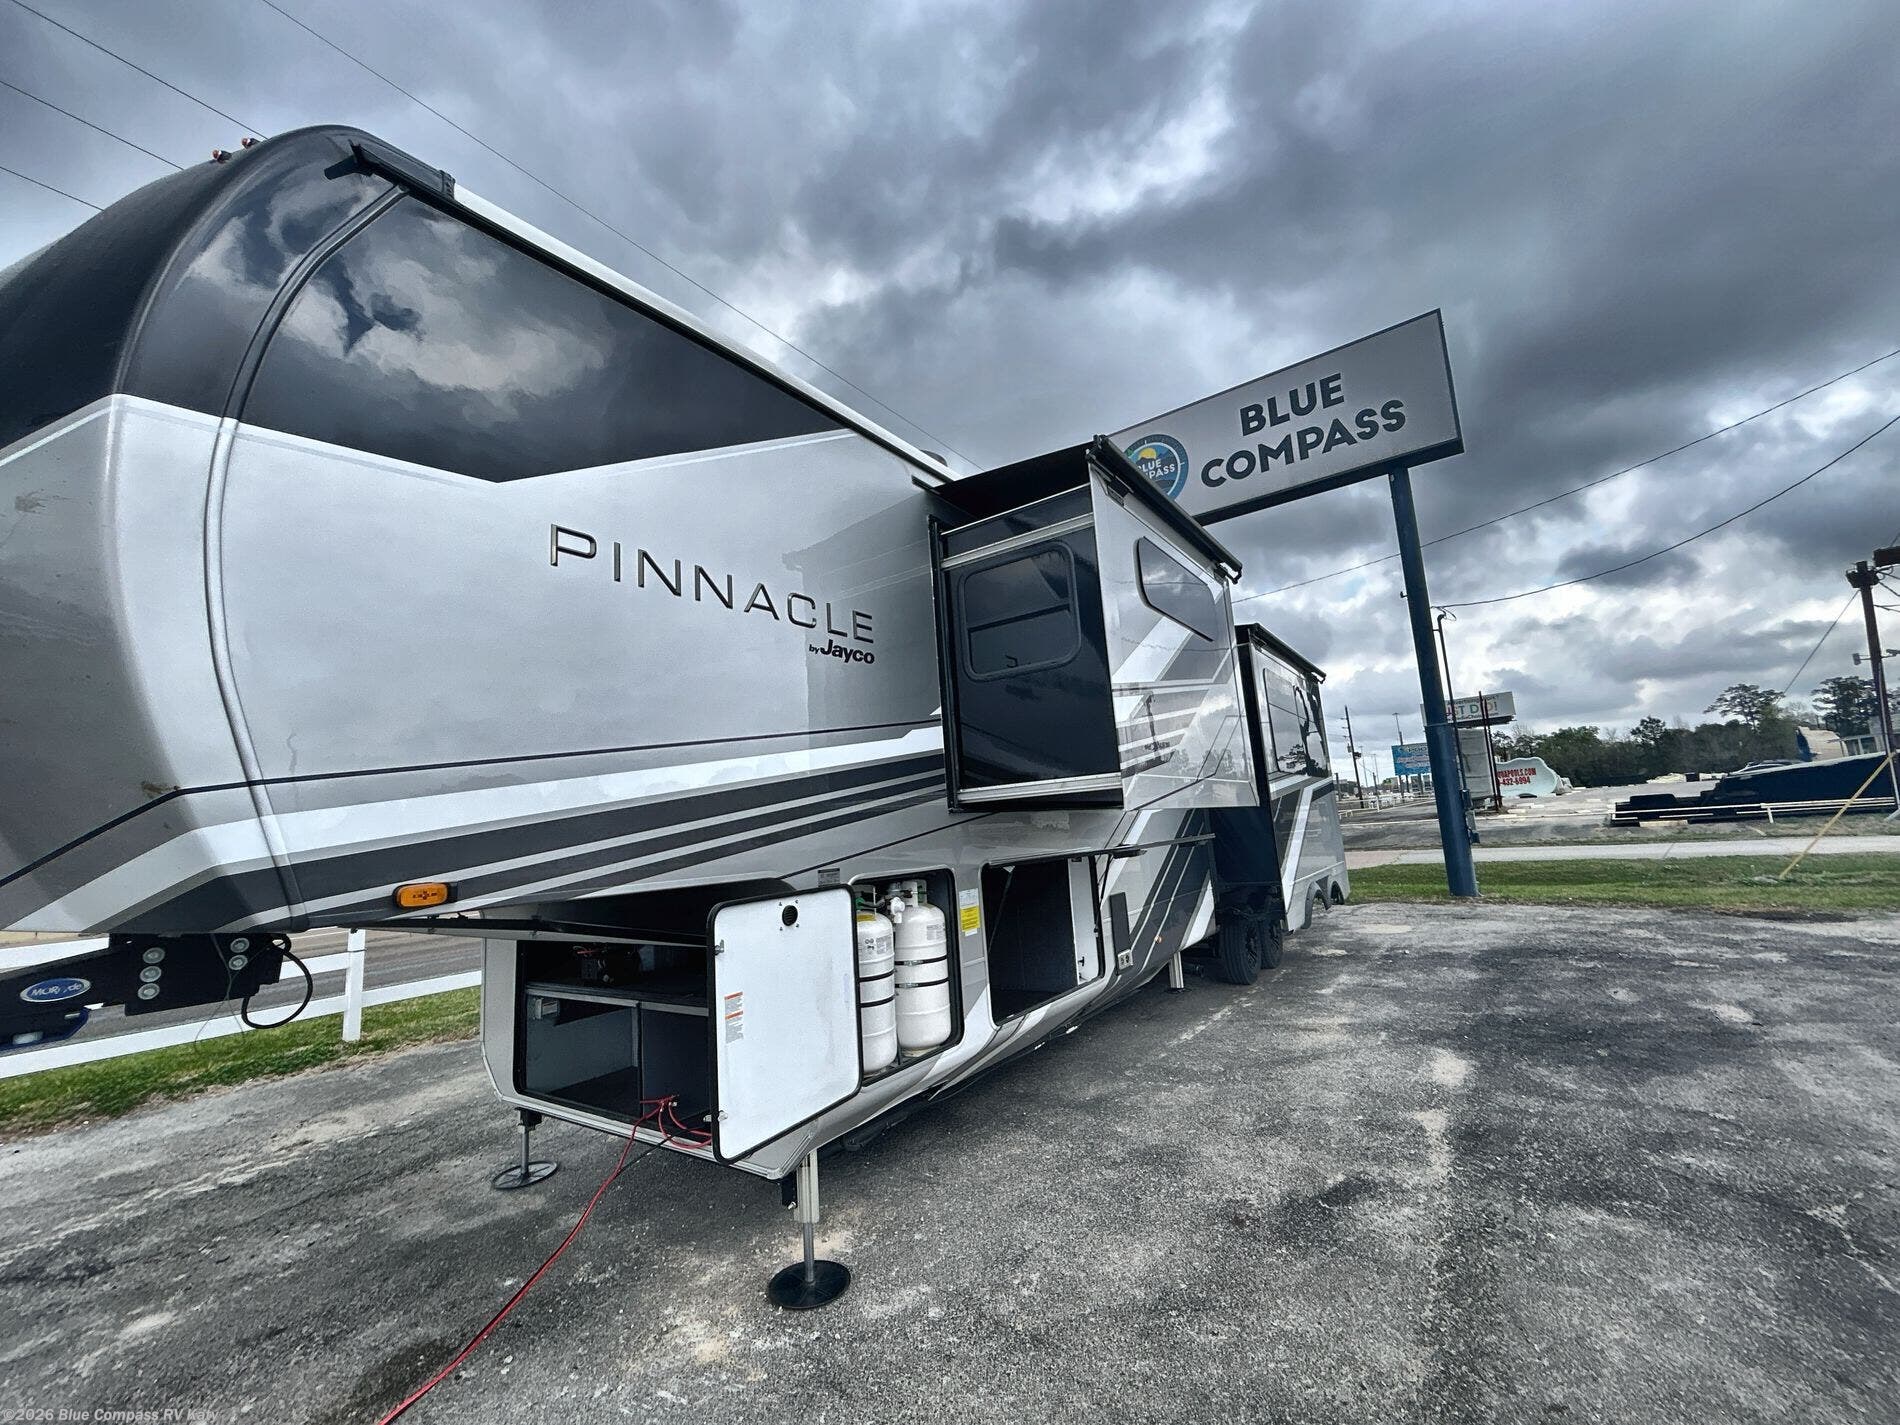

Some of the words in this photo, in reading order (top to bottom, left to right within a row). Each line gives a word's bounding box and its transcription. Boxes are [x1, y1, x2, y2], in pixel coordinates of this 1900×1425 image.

[1240, 373, 1345, 436] BLUE
[1200, 400, 1407, 487] COMPASS
[550, 523, 874, 643] PINNACLE
[808, 643, 820, 655] by
[819, 639, 875, 664] Jayco
[31, 983, 82, 996] MORde
